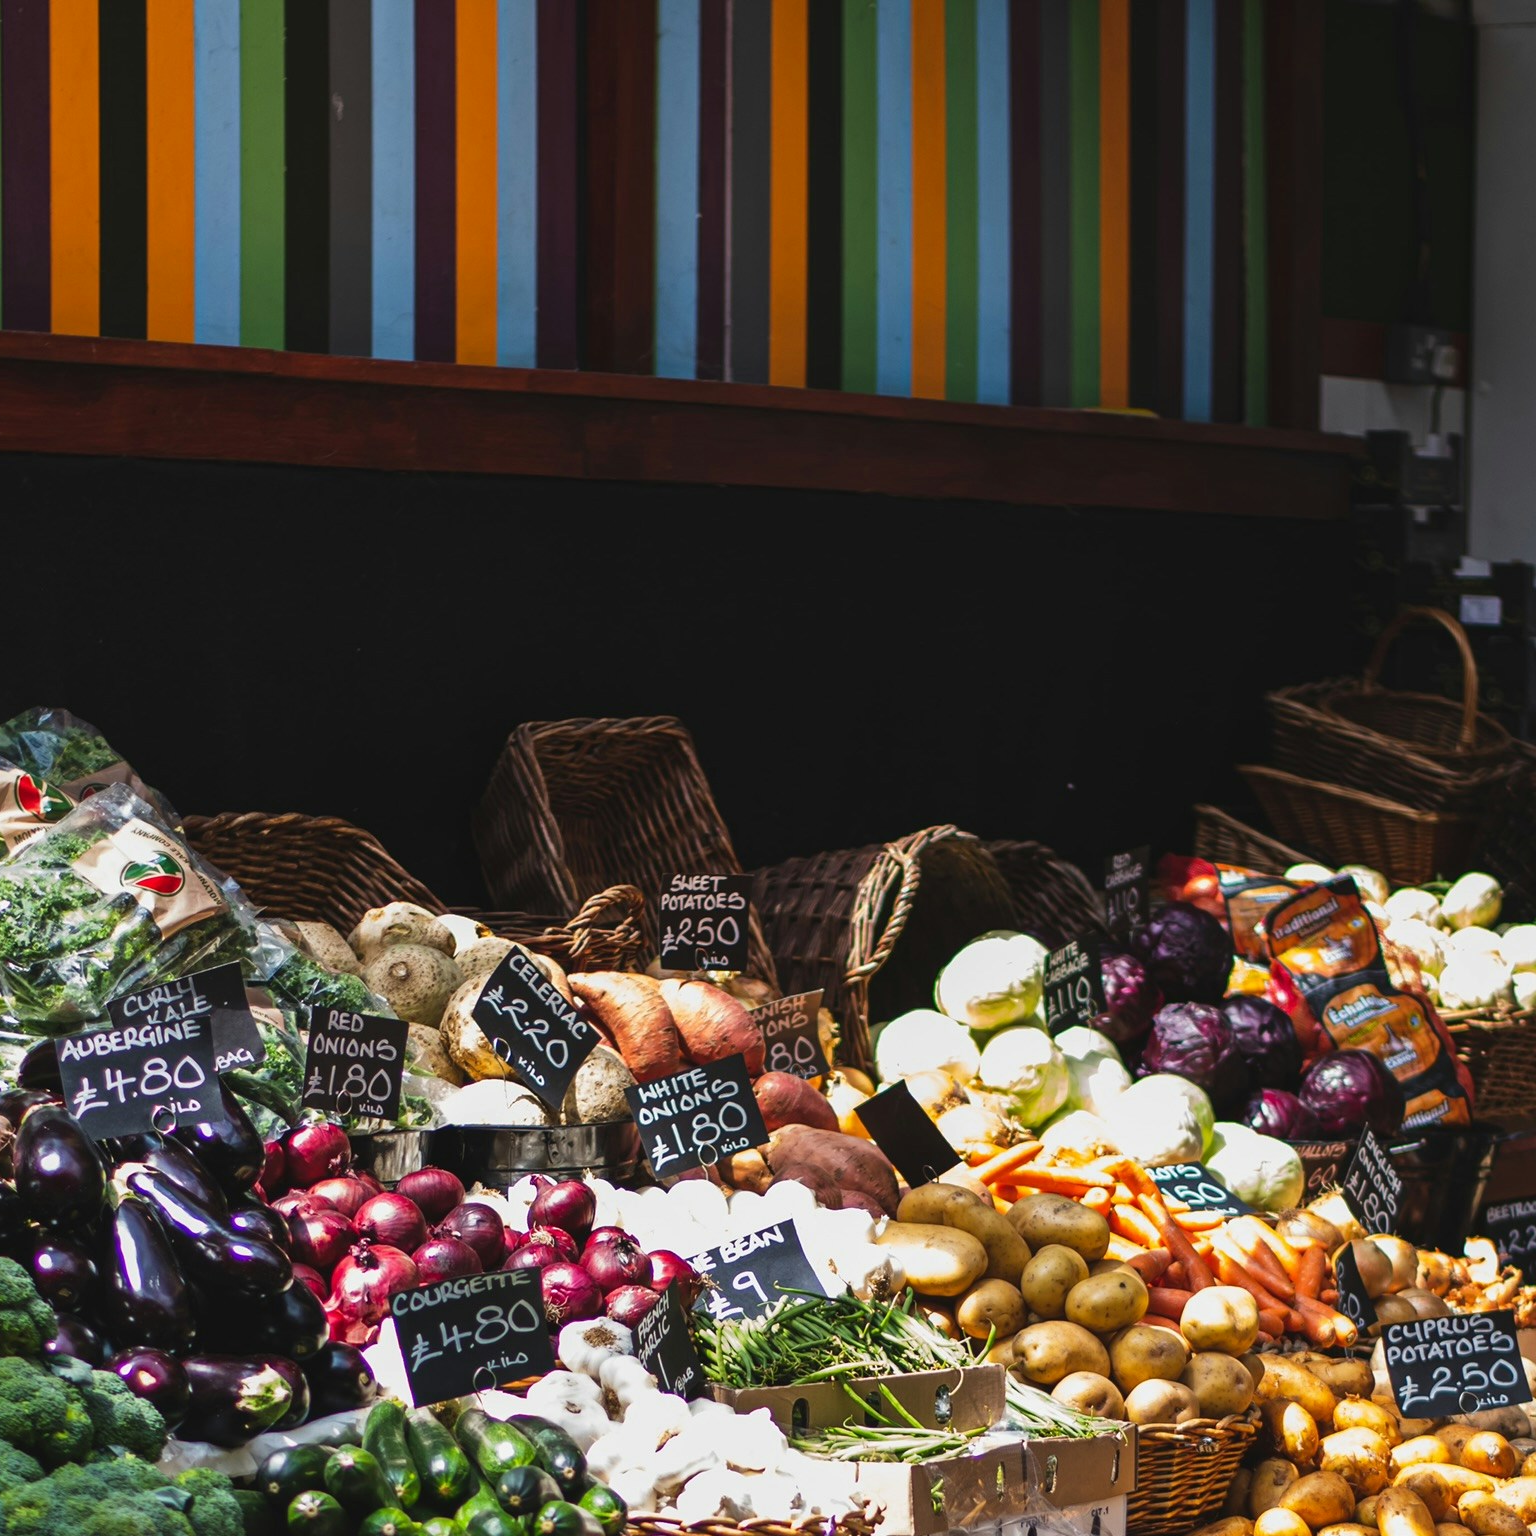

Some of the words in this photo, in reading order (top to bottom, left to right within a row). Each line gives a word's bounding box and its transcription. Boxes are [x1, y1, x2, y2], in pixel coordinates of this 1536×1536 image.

[661, 892, 746, 911] POTATOES
[670, 874, 728, 892] SWEET
[661, 916, 740, 957] £2.50
[123, 976, 199, 1018] CURLY
[147, 994, 212, 1025] KALE
[509, 954, 588, 1040] CELERIAC
[752, 994, 807, 1021] ANISH
[61, 1019, 201, 1062] AUBERGINE
[328, 1010, 364, 1033] RED
[482, 985, 568, 1069] £2.20
[759, 1011, 809, 1037] IONS
[313, 1032, 398, 1061] ONIONS
[73, 1055, 206, 1120] £4.80
[304, 1063, 392, 1102] £1.80
[637, 1068, 708, 1104] WHITE
[638, 1078, 740, 1126] ONIONS
[650, 1101, 748, 1172] £1.80
[1358, 1146, 1397, 1216] ONIONS
[1365, 1130, 1402, 1196] ENGLISH
[718, 1225, 785, 1264] BEAN
[392, 1269, 532, 1317] COURGETTE
[411, 1299, 540, 1373] £4.80
[637, 1289, 670, 1345] FRENCH
[1387, 1313, 1494, 1343] CYPRUS
[638, 1315, 671, 1370] GARLIC
[1386, 1330, 1515, 1366] POTATOES
[1399, 1358, 1518, 1411] £2.50
